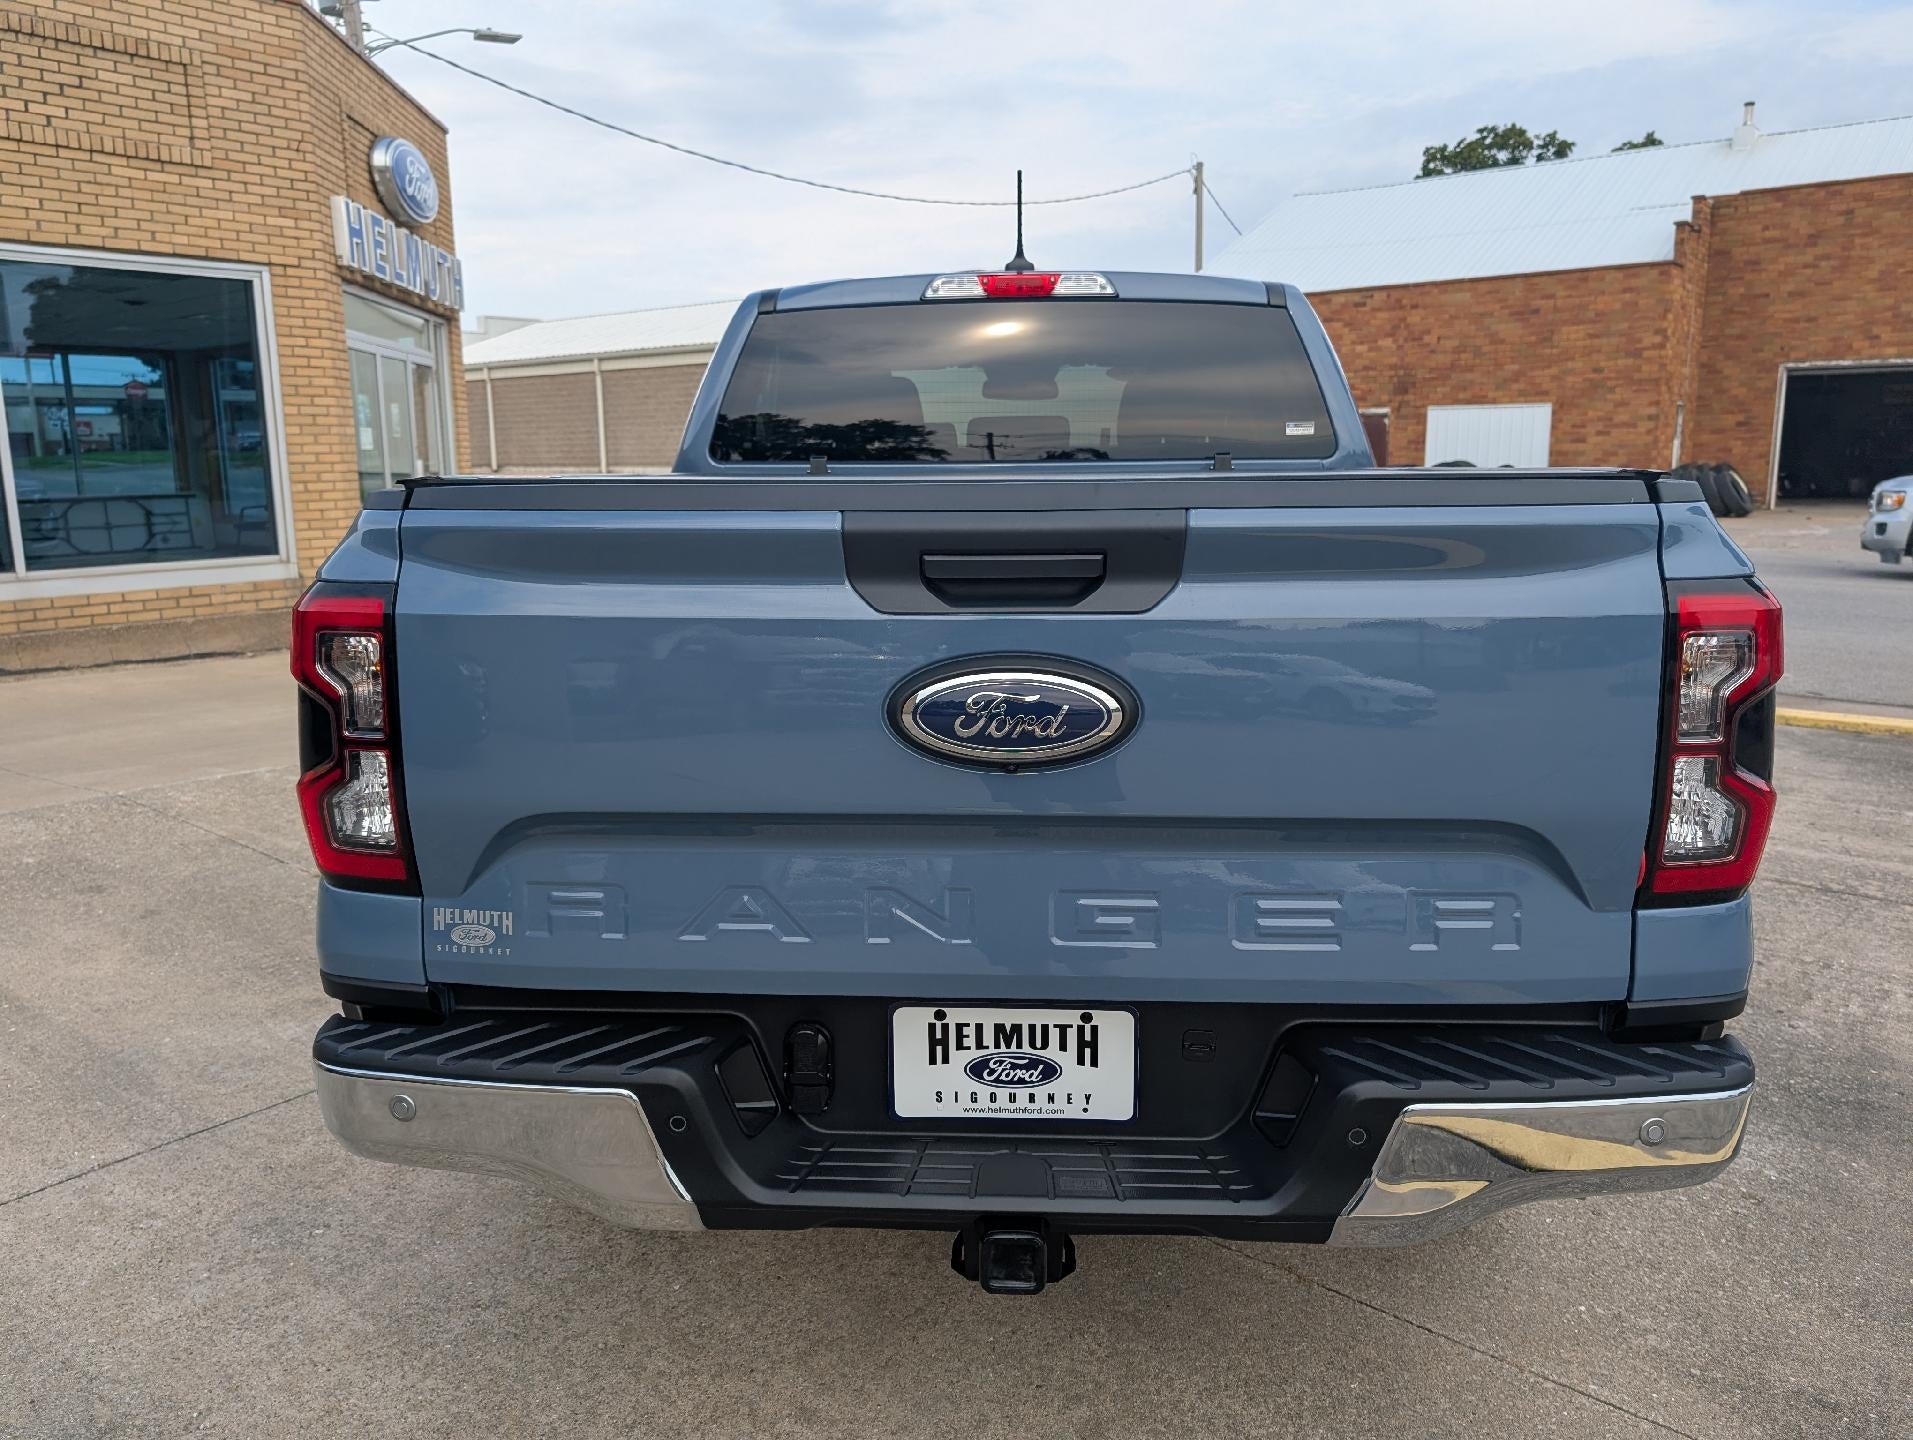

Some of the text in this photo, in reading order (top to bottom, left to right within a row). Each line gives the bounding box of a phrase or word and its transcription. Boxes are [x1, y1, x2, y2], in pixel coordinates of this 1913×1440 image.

[405, 156, 434, 204] Ford
[343, 196, 464, 312] HELMUTH
[954, 691, 1070, 738] Ford
[433, 907, 513, 936] HELMUTH
[459, 928, 488, 942] Ford
[525, 880, 1523, 952] RANGER
[927, 1022, 1100, 1069] HELMUTH
[983, 1057, 1043, 1083] Ford
[935, 1090, 1092, 1106] SIGOURNEY
[962, 1105, 1065, 1116] www.helmuthford.com
